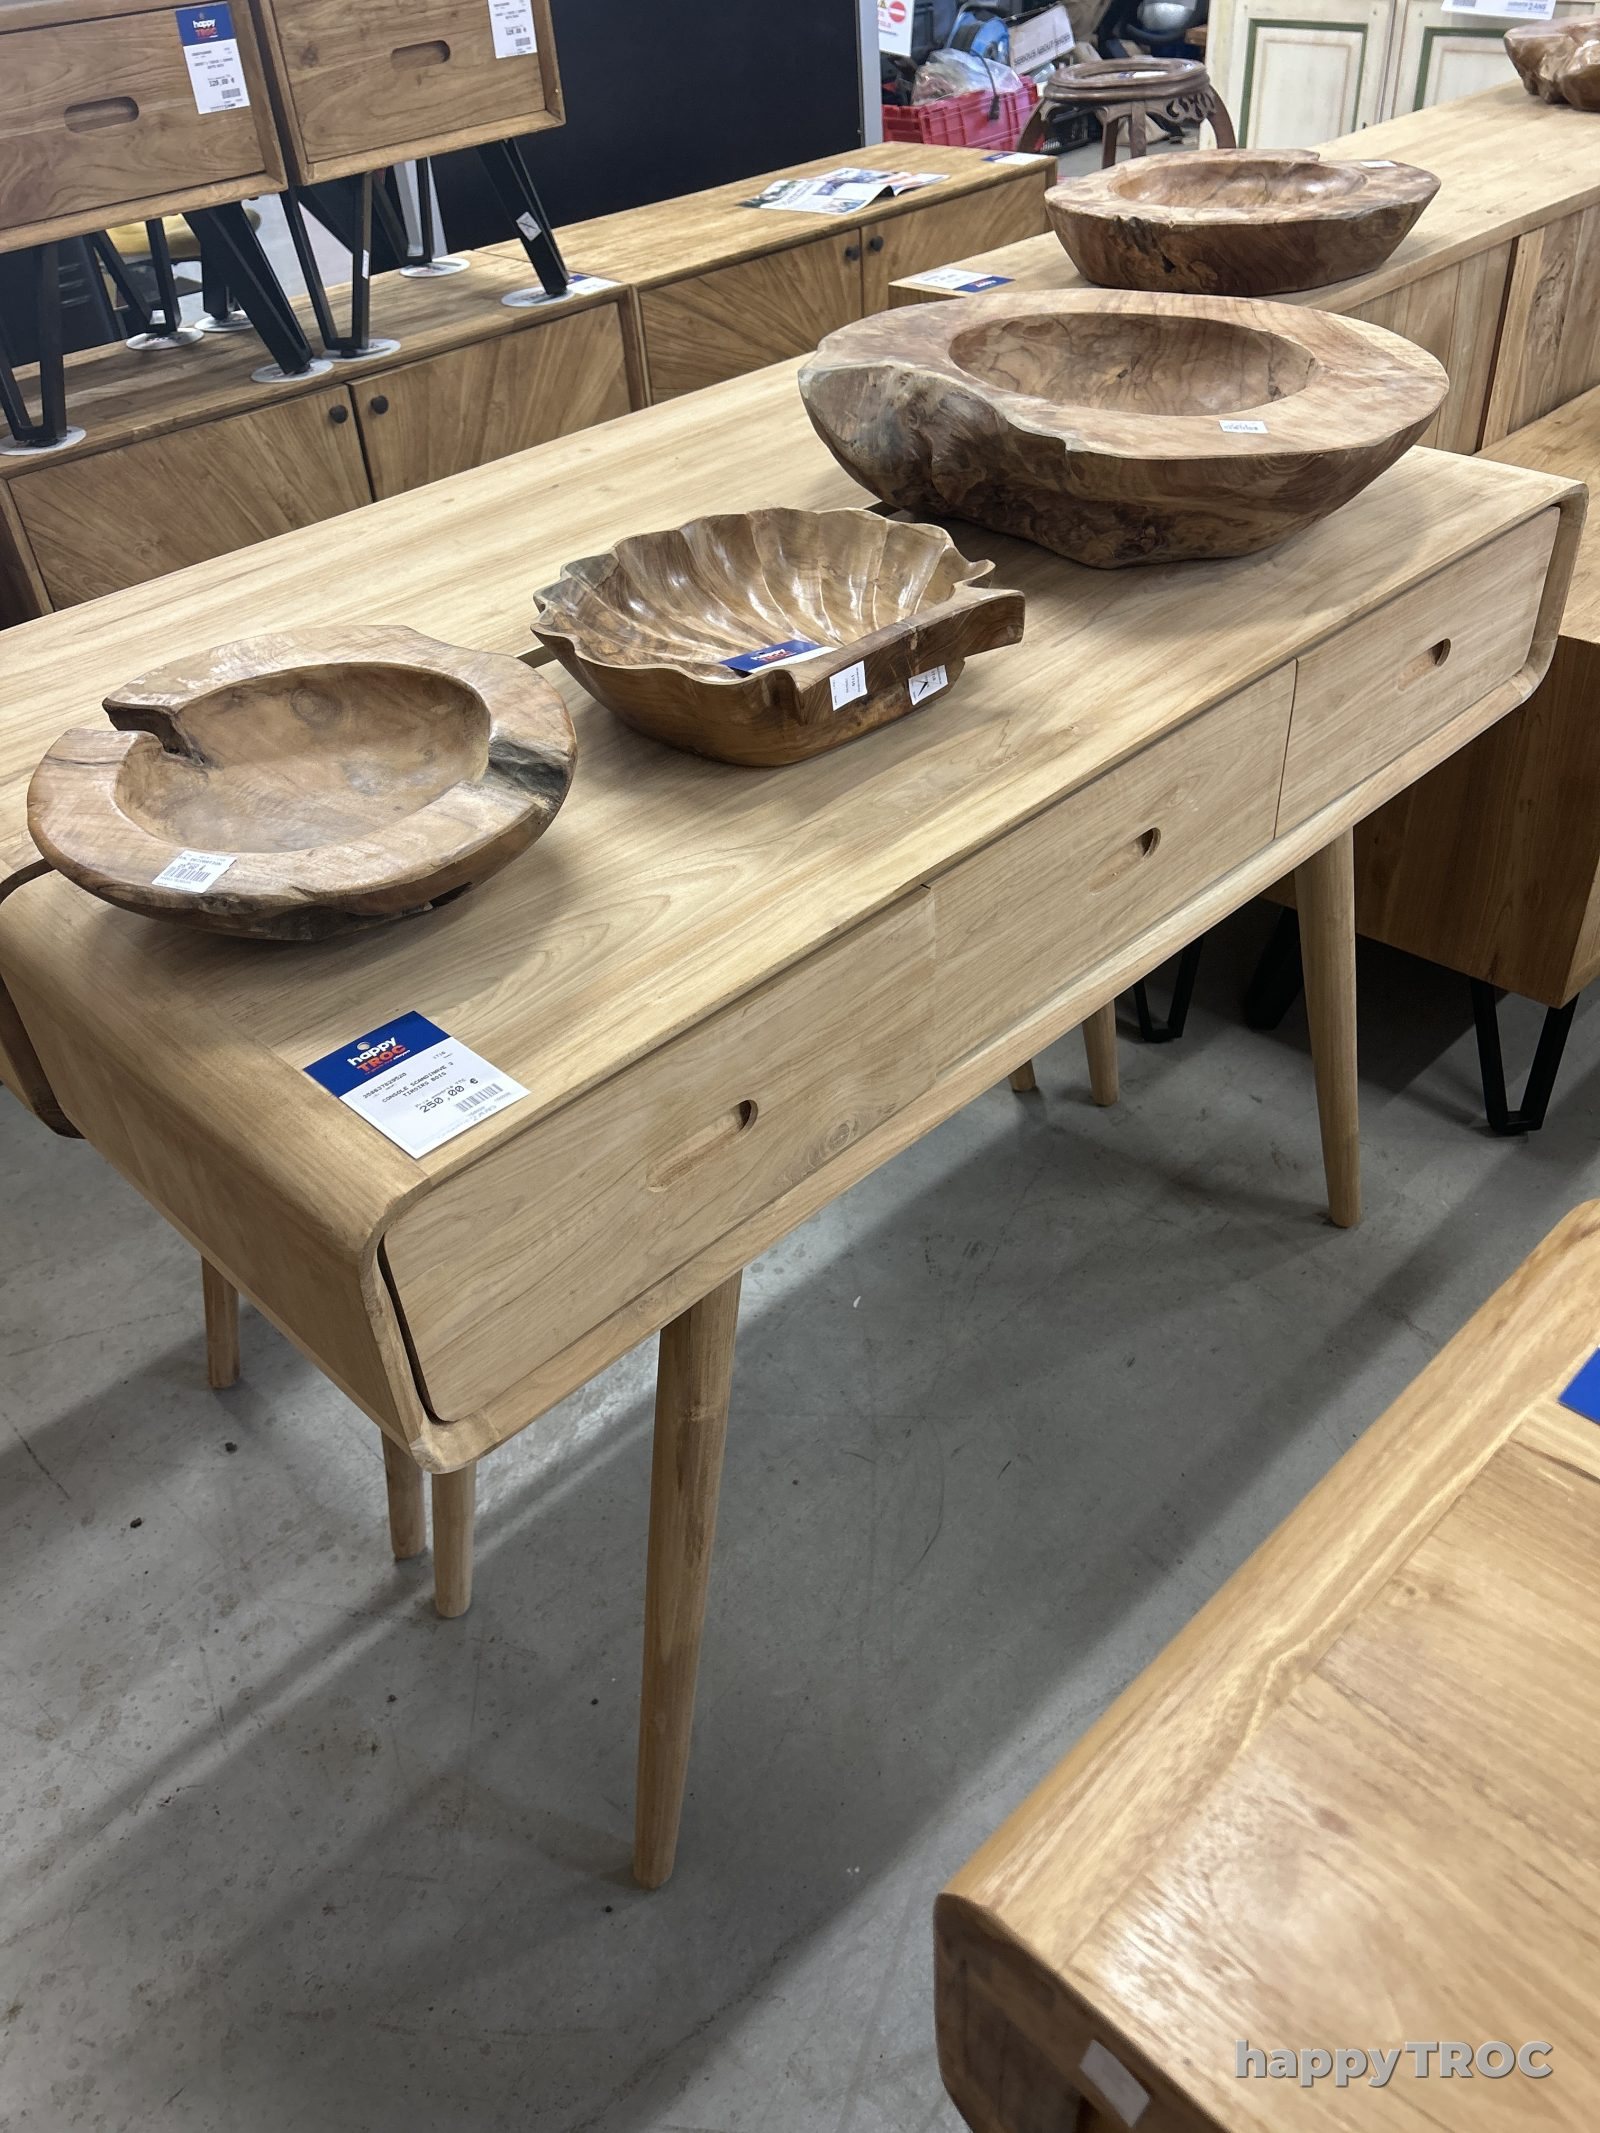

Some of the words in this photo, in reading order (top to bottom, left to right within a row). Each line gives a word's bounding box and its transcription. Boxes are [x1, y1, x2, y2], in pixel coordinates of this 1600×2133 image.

[193, 19, 216, 29] happy
[347, 1036, 397, 1066] happy
[356, 1045, 406, 1072] TROC
[382, 1086, 409, 1103] CONSOLE
[409, 1065, 447, 1087] SCANDINAVE
[402, 1081, 430, 1097] TIROIRS
[430, 1071, 447, 1082] BOIS
[469, 1077, 479, 1085] €
